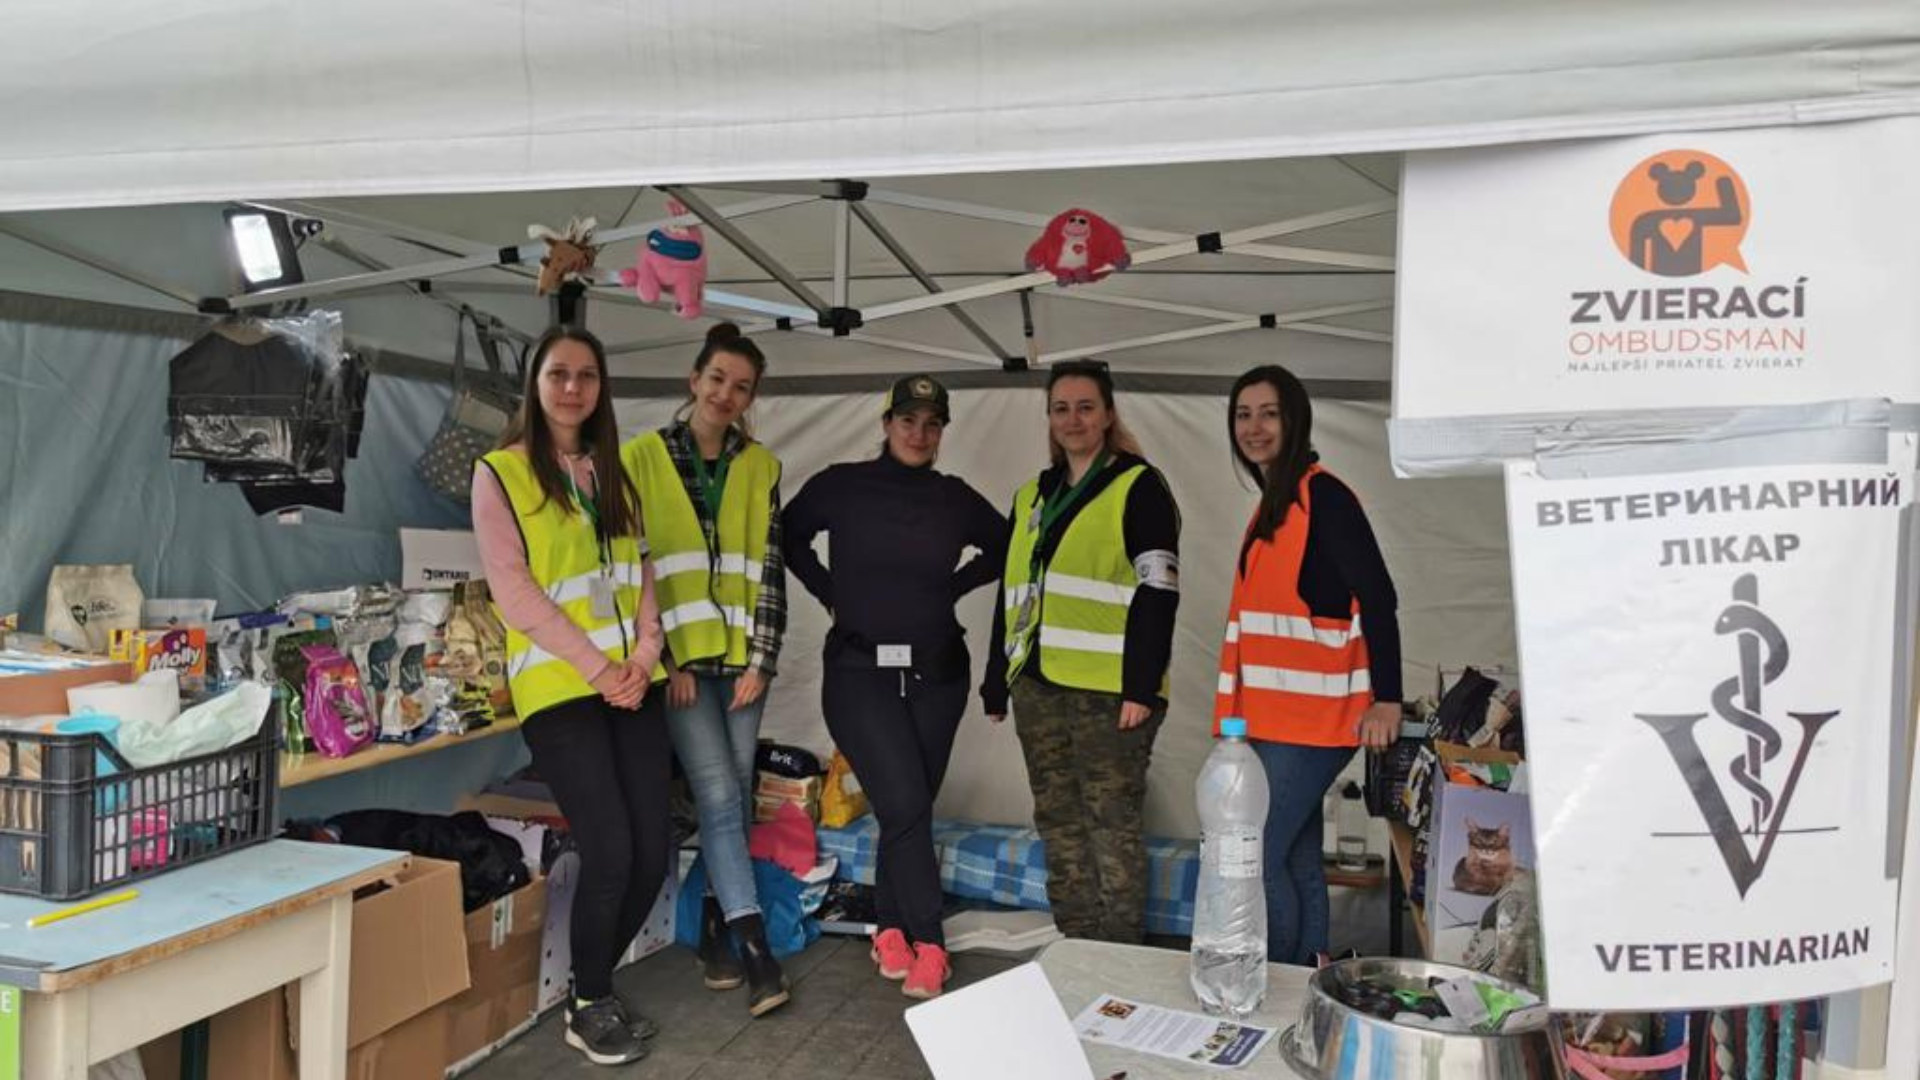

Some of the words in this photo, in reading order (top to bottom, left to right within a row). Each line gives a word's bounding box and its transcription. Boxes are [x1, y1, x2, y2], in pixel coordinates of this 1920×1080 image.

[1570, 276, 1809, 324] ZVIERACÍ
[1569, 327, 1805, 356] OMBUDSMAN
[1733, 356, 1805, 369] ZVIERAT
[1535, 472, 1900, 528] ВЕТЕРИНАРНИЙ
[1658, 533, 1801, 567] ЛІКАР
[149, 646, 202, 672] Molly
[1595, 926, 1871, 973] VETERINARIAN
